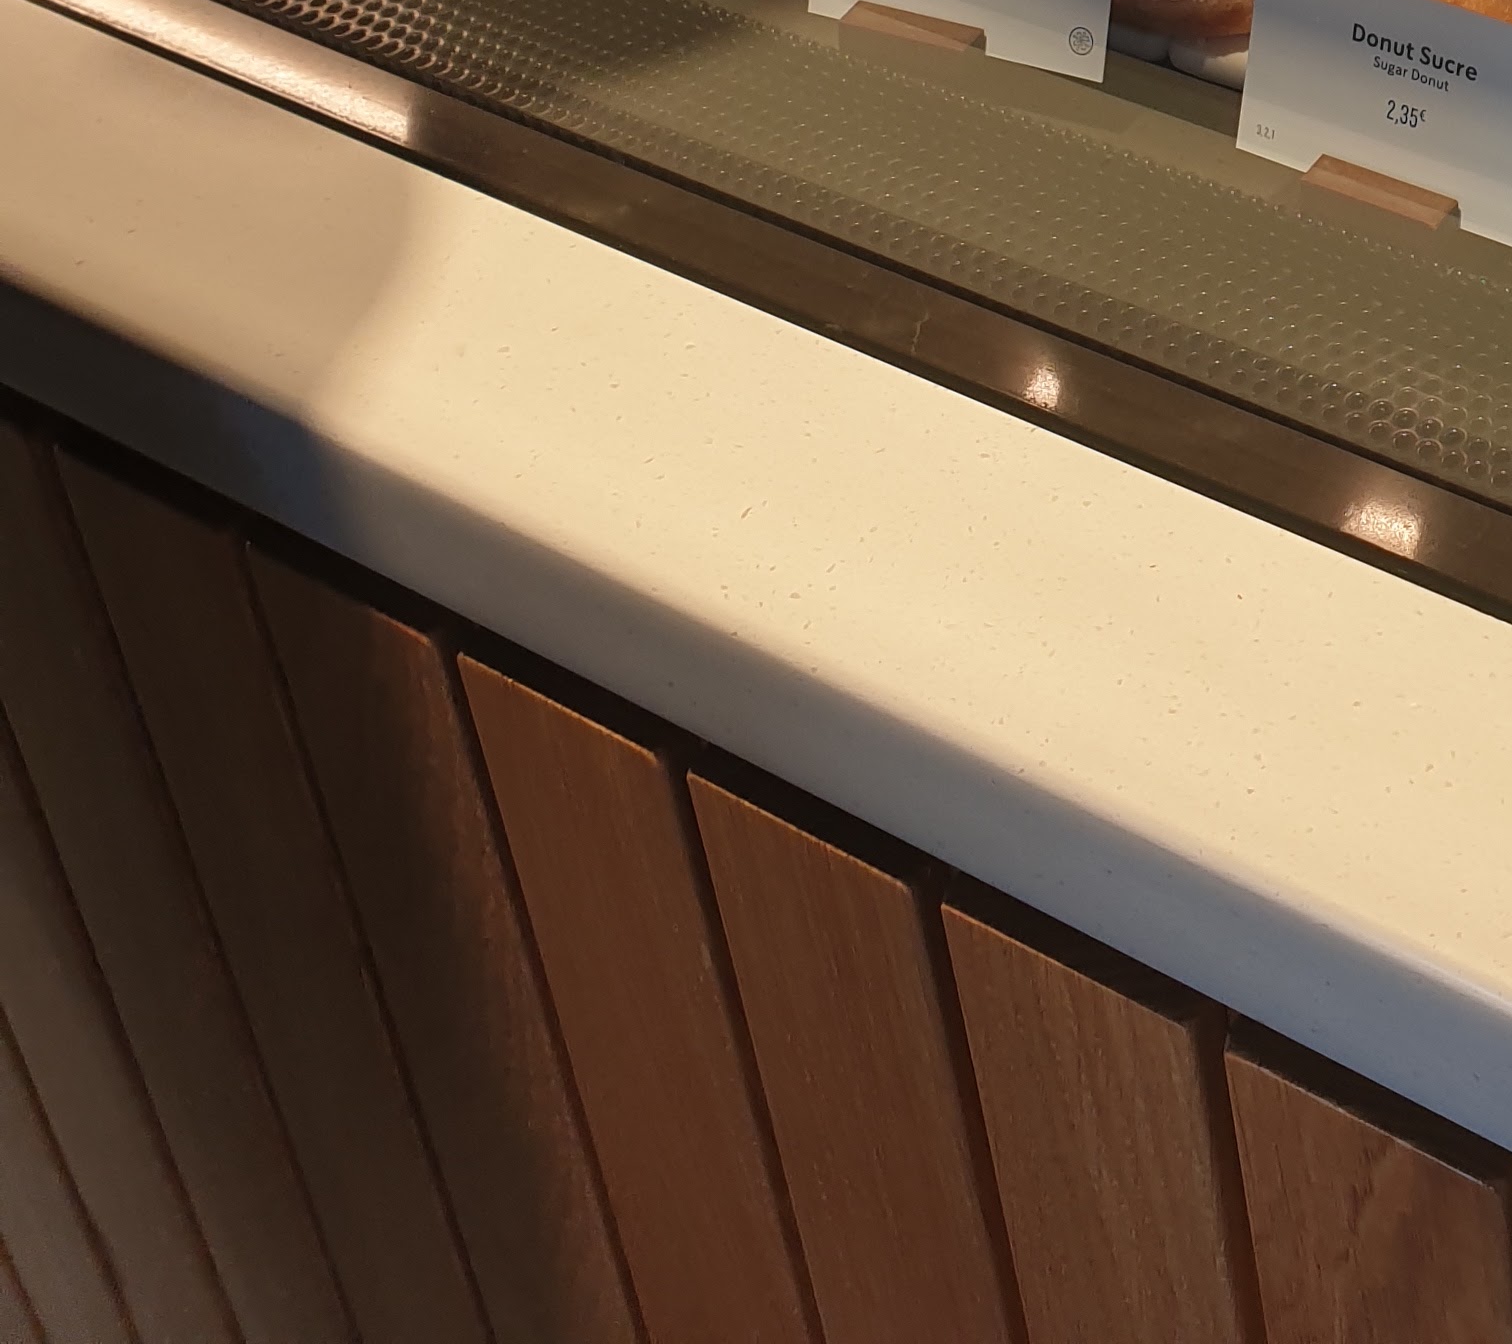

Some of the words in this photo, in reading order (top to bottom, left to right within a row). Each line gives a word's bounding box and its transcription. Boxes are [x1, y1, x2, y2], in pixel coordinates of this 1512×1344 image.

[1352, 22, 1414, 60] Donut
[1420, 45, 1478, 81] Sucre
[1373, 56, 1408, 78] Sugar
[1411, 68, 1449, 92] Donut
[1386, 100, 1426, 128] 2,35€
